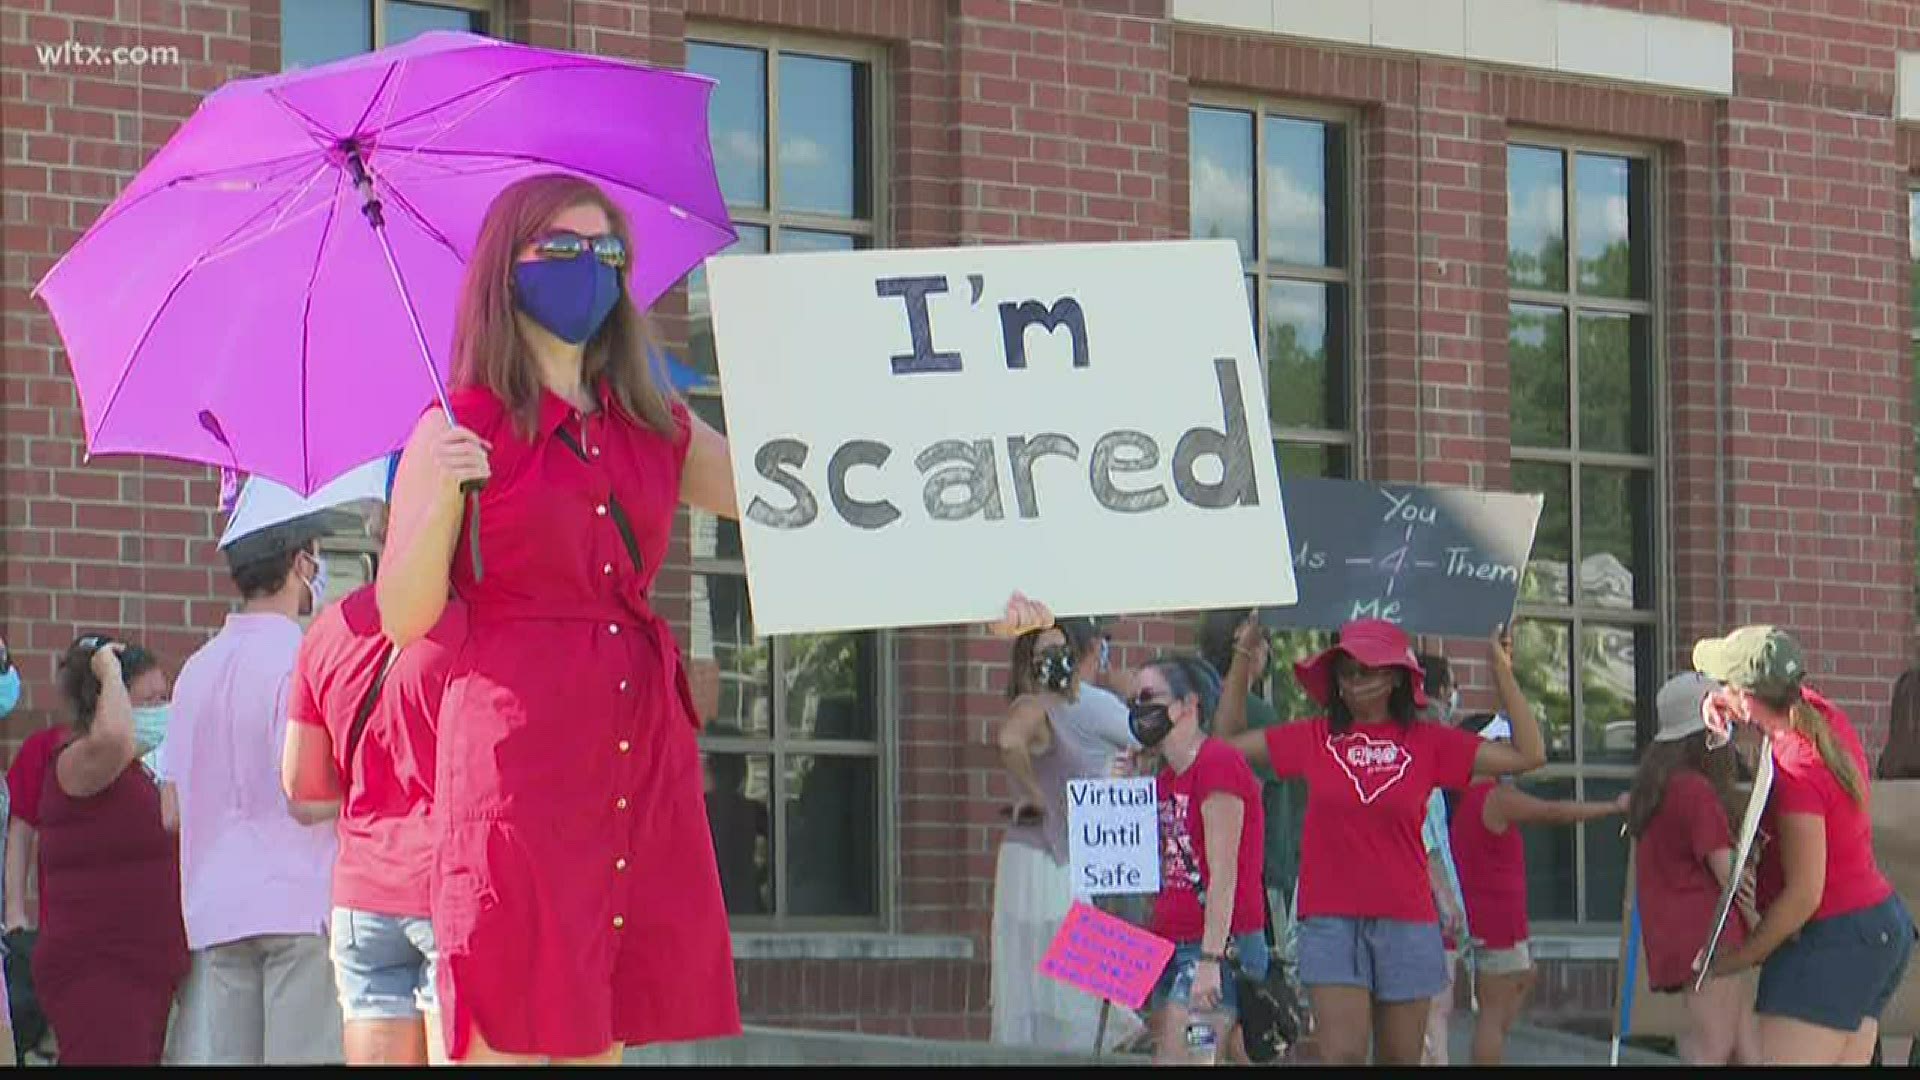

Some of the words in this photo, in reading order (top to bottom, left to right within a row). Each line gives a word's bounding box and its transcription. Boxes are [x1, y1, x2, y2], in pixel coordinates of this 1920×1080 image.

[875, 274, 1090, 375] I'm
[746, 358, 1260, 529] scared
[1380, 487, 1438, 525] You
[1444, 546, 1518, 584] Them
[1350, 599, 1402, 624] Me
[1070, 782, 1154, 807] Virtual
[1083, 822, 1140, 847] Until
[1083, 862, 1140, 888] Safe
